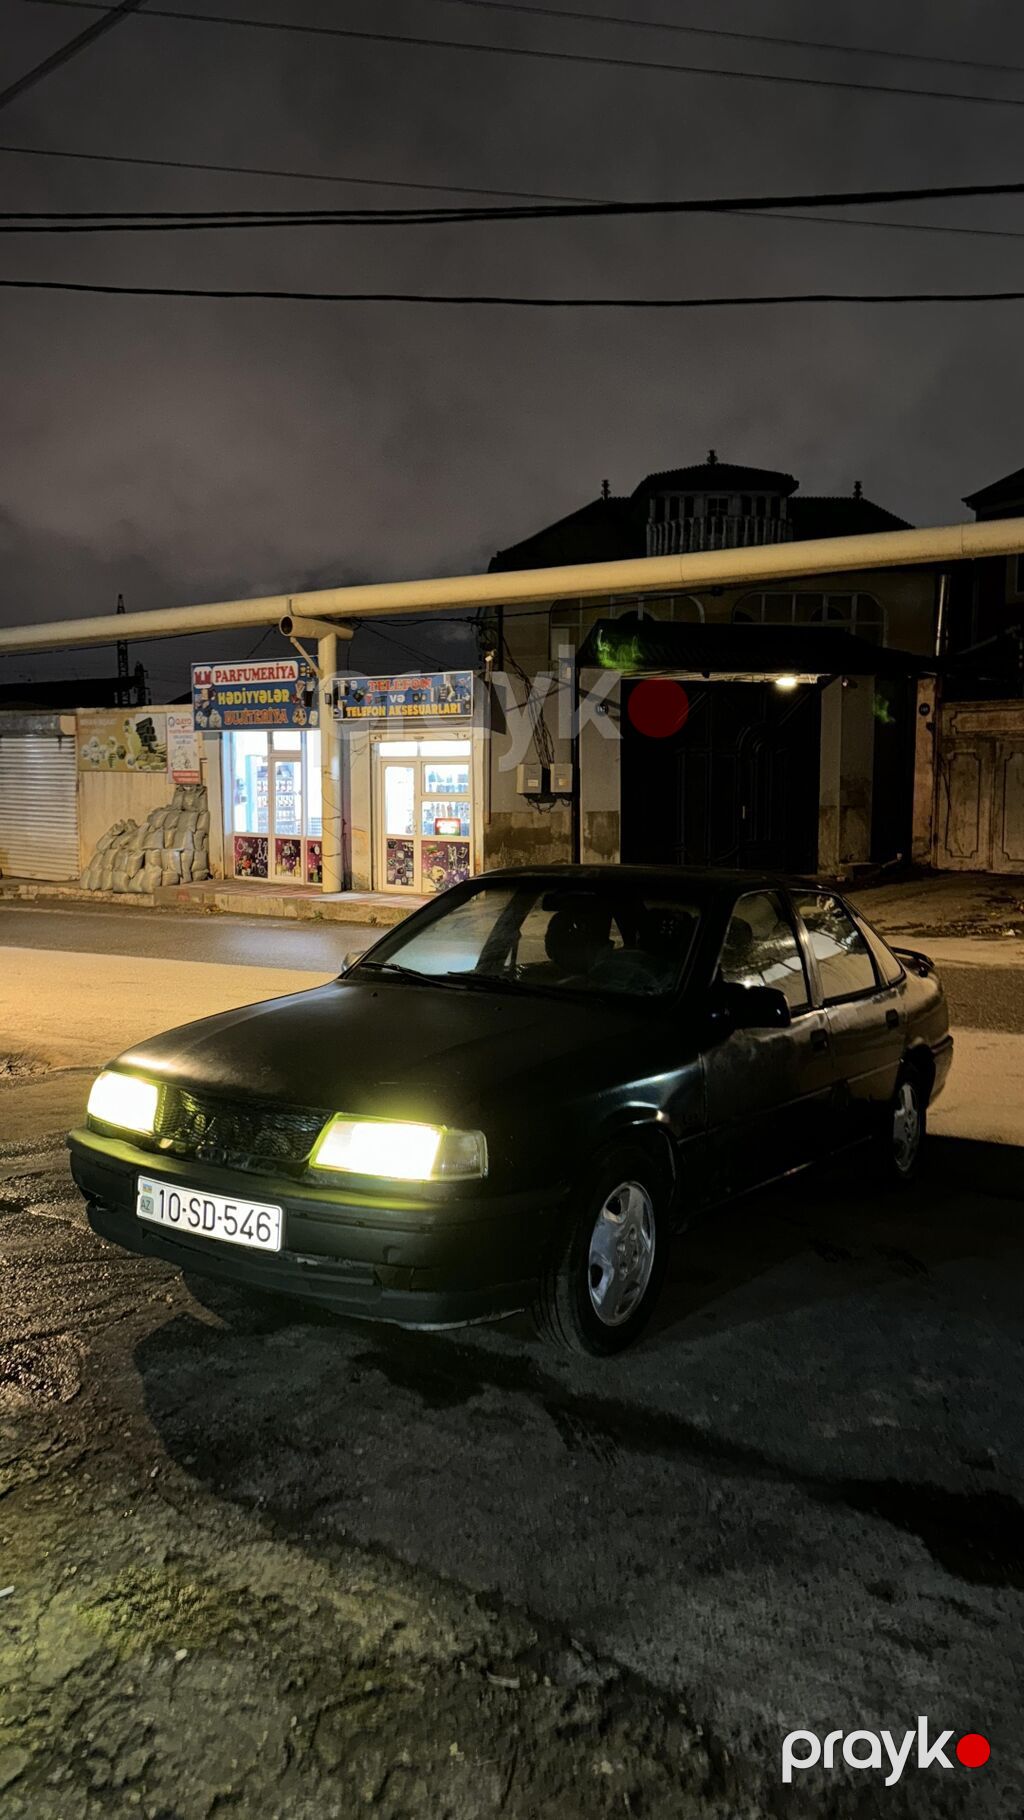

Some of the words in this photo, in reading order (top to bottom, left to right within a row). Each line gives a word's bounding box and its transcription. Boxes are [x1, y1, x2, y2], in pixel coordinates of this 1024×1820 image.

[215, 663, 296, 683] PARFUMERİYA
[368, 678, 432, 692] TELEFON
[217, 687, 290, 705] HƏDİYYƏLƏR
[345, 705, 386, 717] TELEFON
[388, 702, 461, 716] AKSESUARLARI
